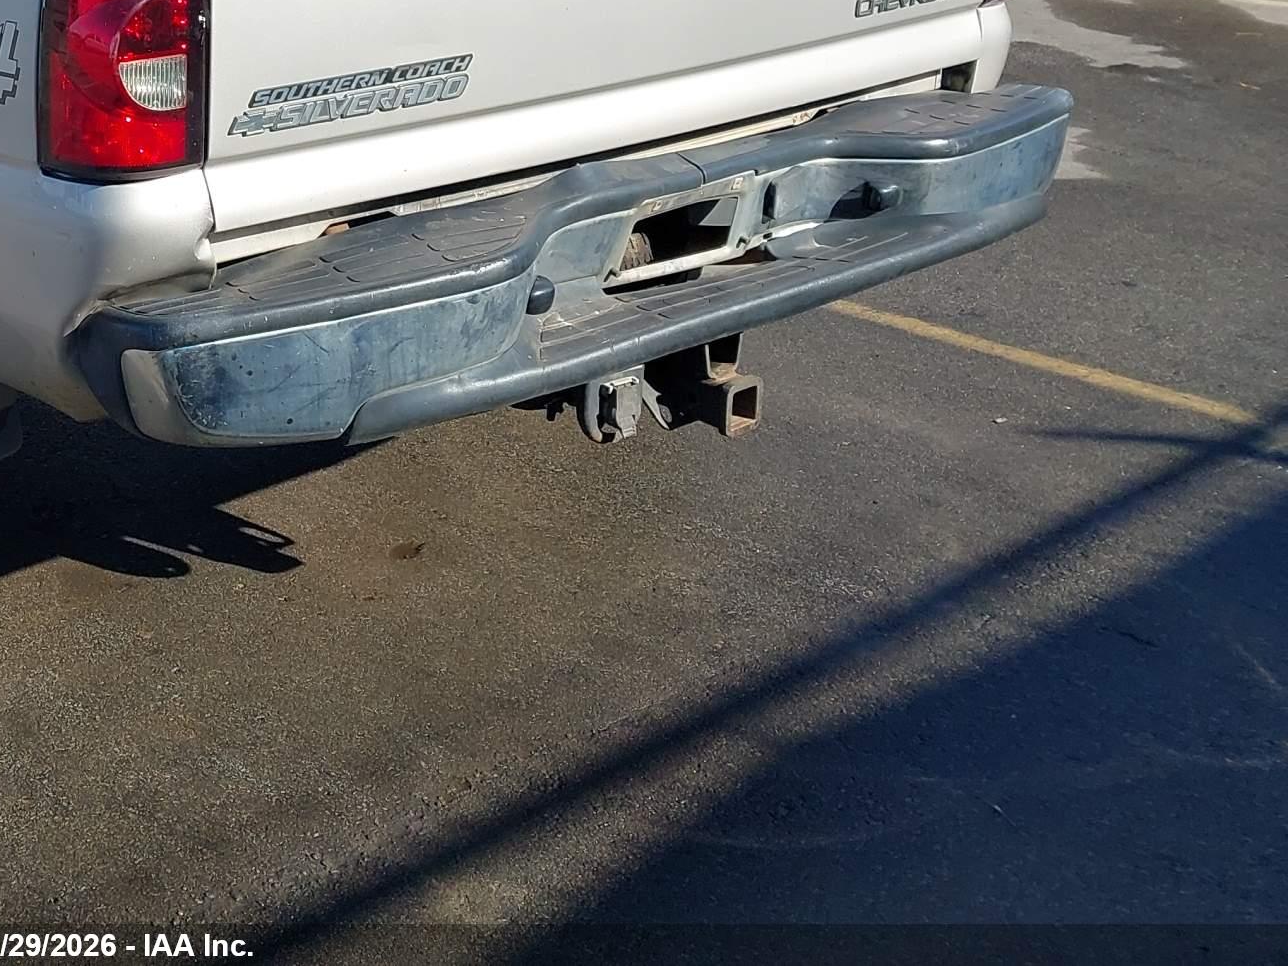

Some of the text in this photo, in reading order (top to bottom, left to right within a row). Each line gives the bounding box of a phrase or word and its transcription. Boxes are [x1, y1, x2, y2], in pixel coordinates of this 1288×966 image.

[252, 55, 472, 106] SOUTHERN COACH
[271, 74, 470, 131] SILVERADO
